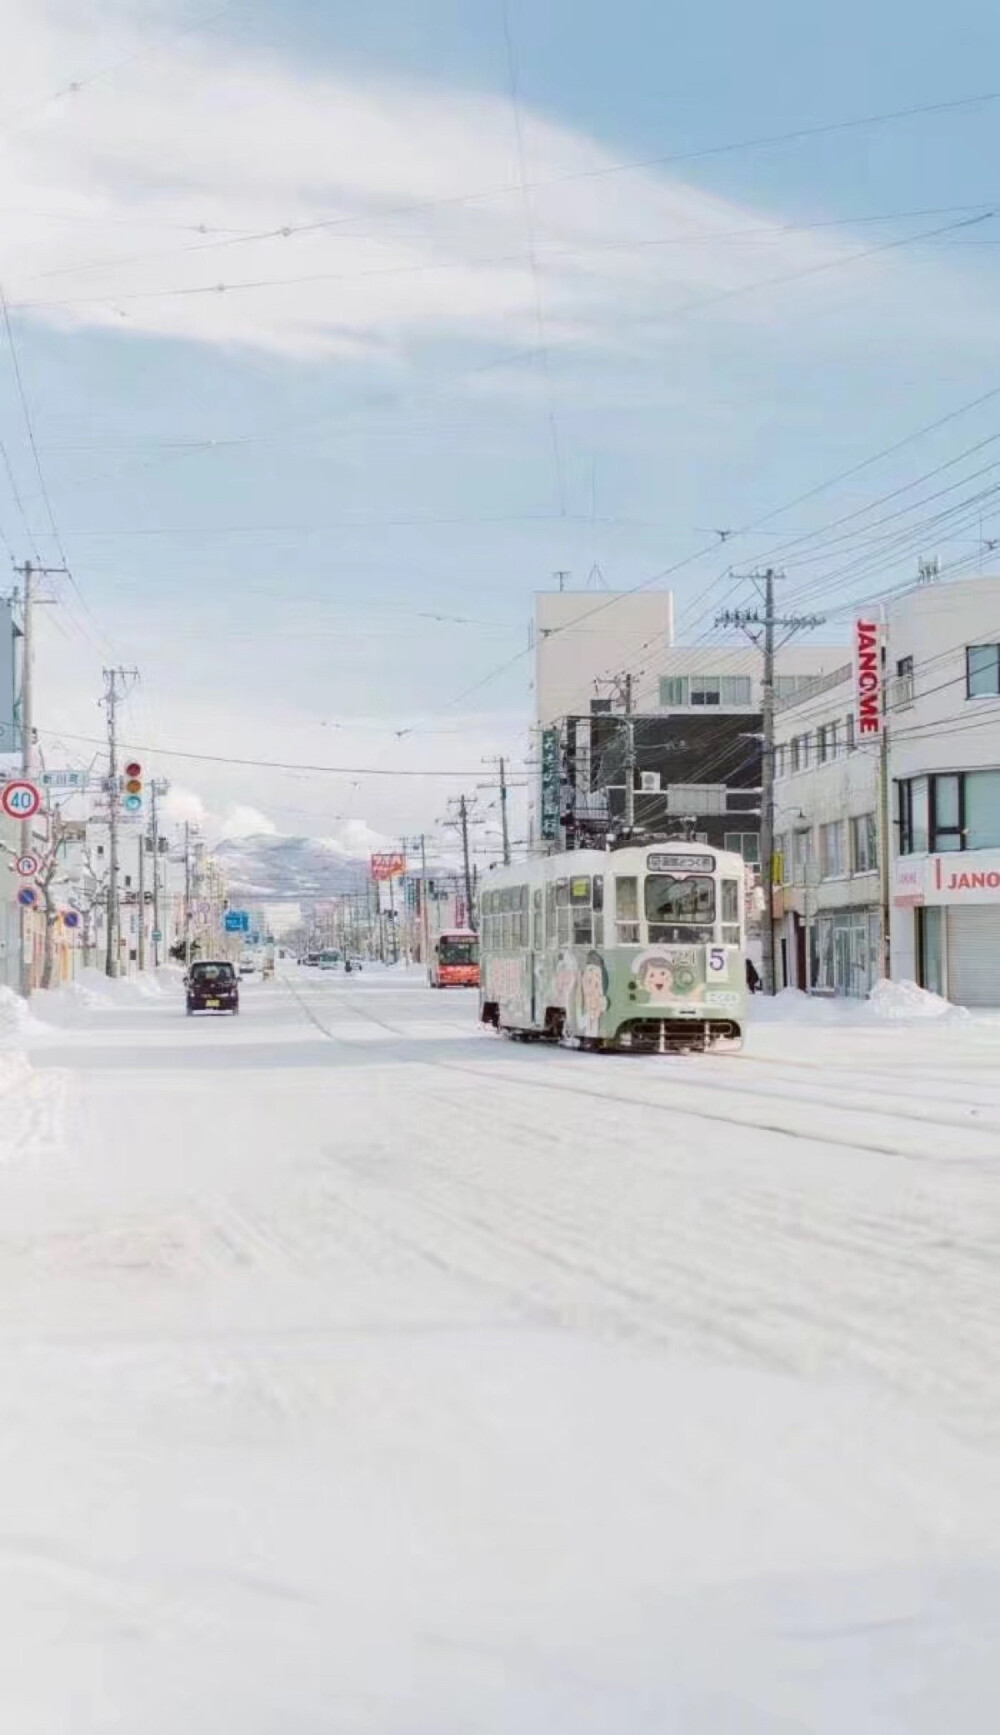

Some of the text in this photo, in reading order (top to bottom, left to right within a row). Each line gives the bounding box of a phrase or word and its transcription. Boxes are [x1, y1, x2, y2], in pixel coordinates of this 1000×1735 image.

[857, 619, 878, 733] JANOME
[10, 792, 31, 809] 40
[948, 871, 1000, 890] JANO
[709, 948, 725, 971] 5
